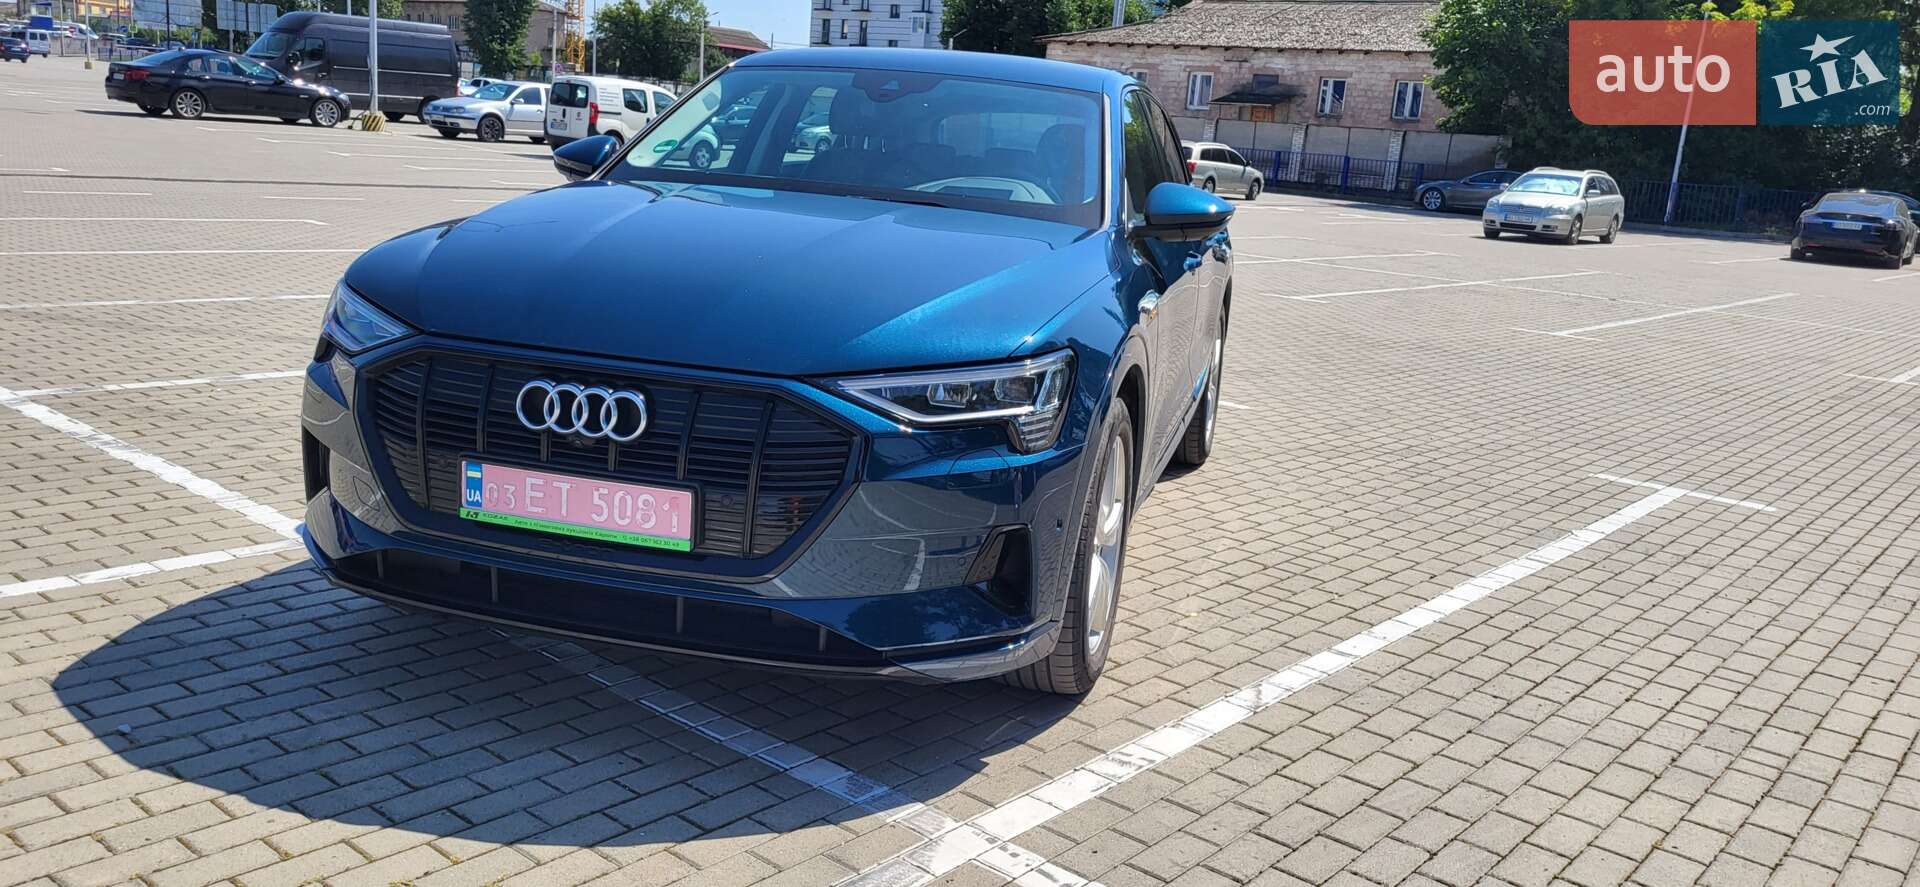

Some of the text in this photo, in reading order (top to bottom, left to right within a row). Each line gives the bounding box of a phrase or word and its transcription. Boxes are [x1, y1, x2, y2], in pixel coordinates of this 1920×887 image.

[466, 488, 482, 503] UA
[486, 477, 680, 533] 03 ET 5081
